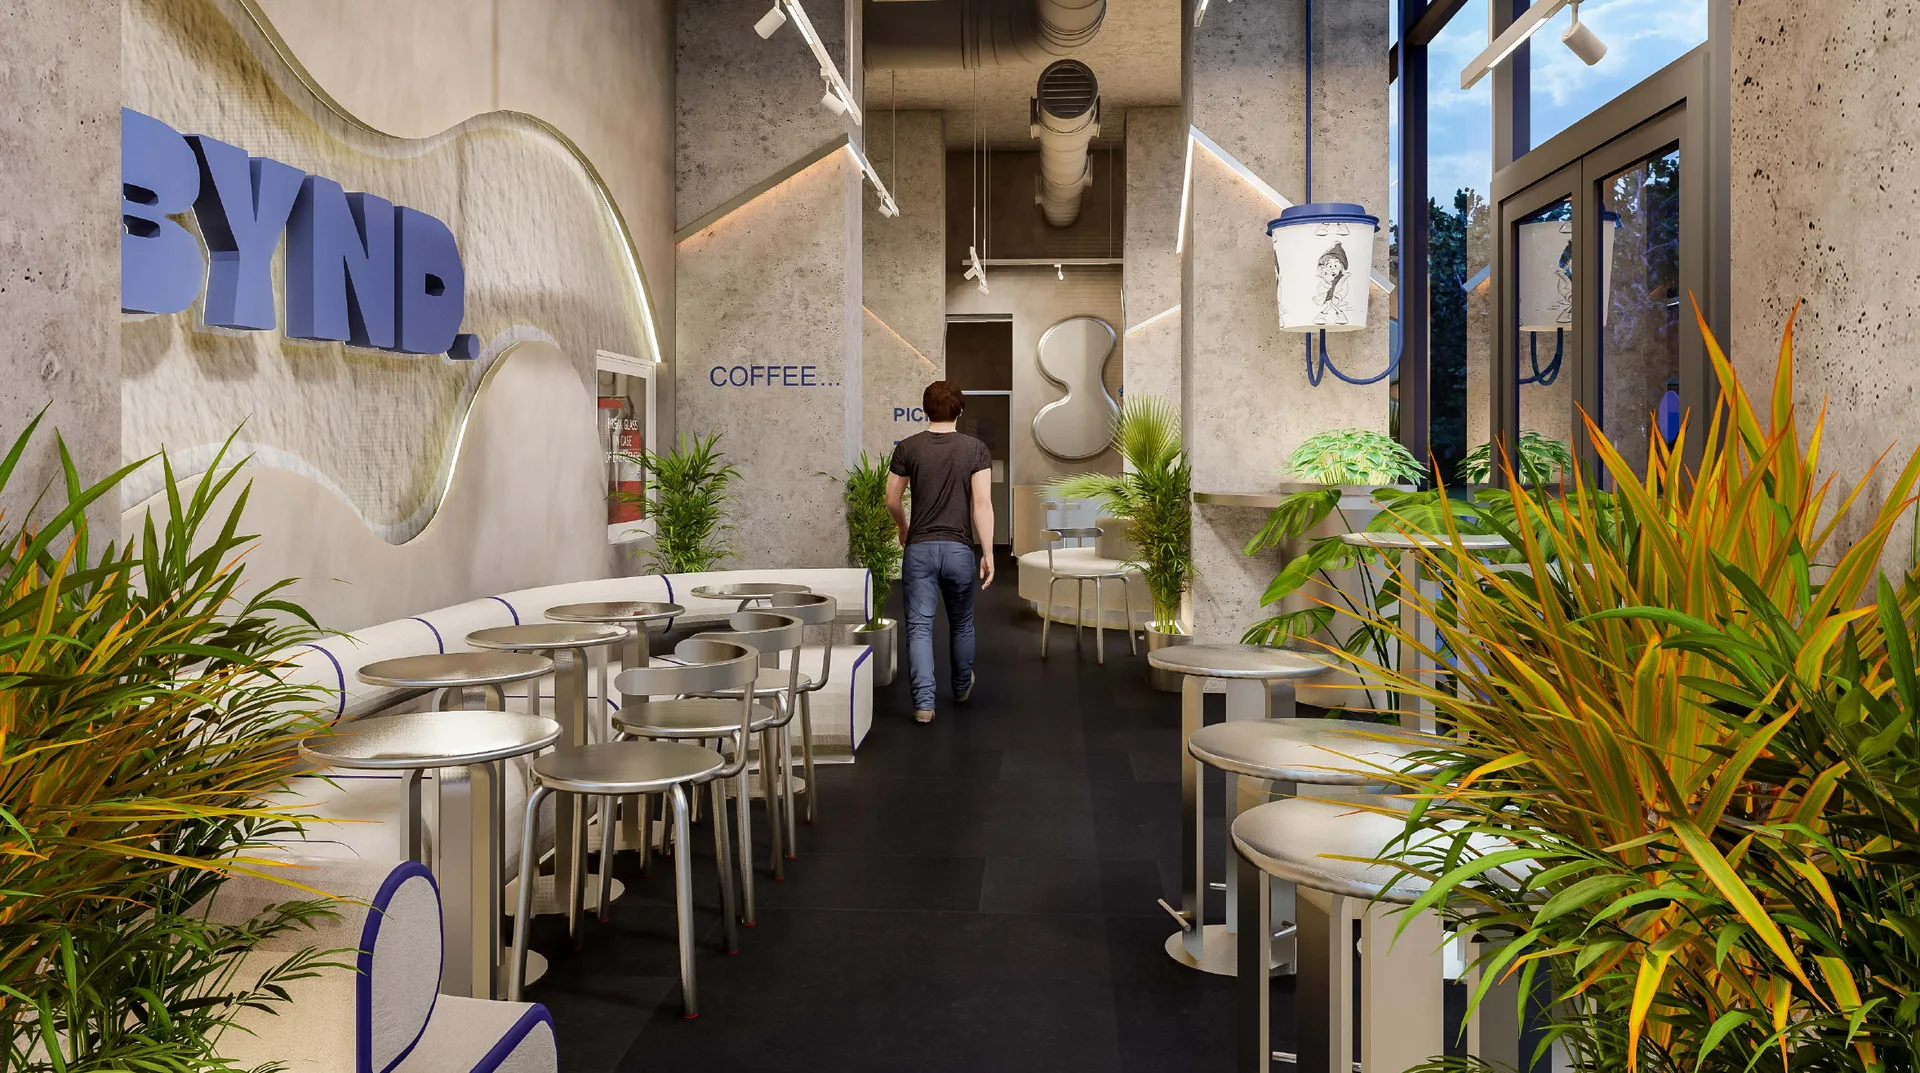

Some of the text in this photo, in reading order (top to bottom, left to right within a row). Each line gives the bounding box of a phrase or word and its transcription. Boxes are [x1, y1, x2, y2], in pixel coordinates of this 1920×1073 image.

[710, 365, 840, 387] COFFEE...
[893, 407, 929, 422] PIC
[624, 419, 638, 430] GLASS
[620, 435, 632, 447] CASE
